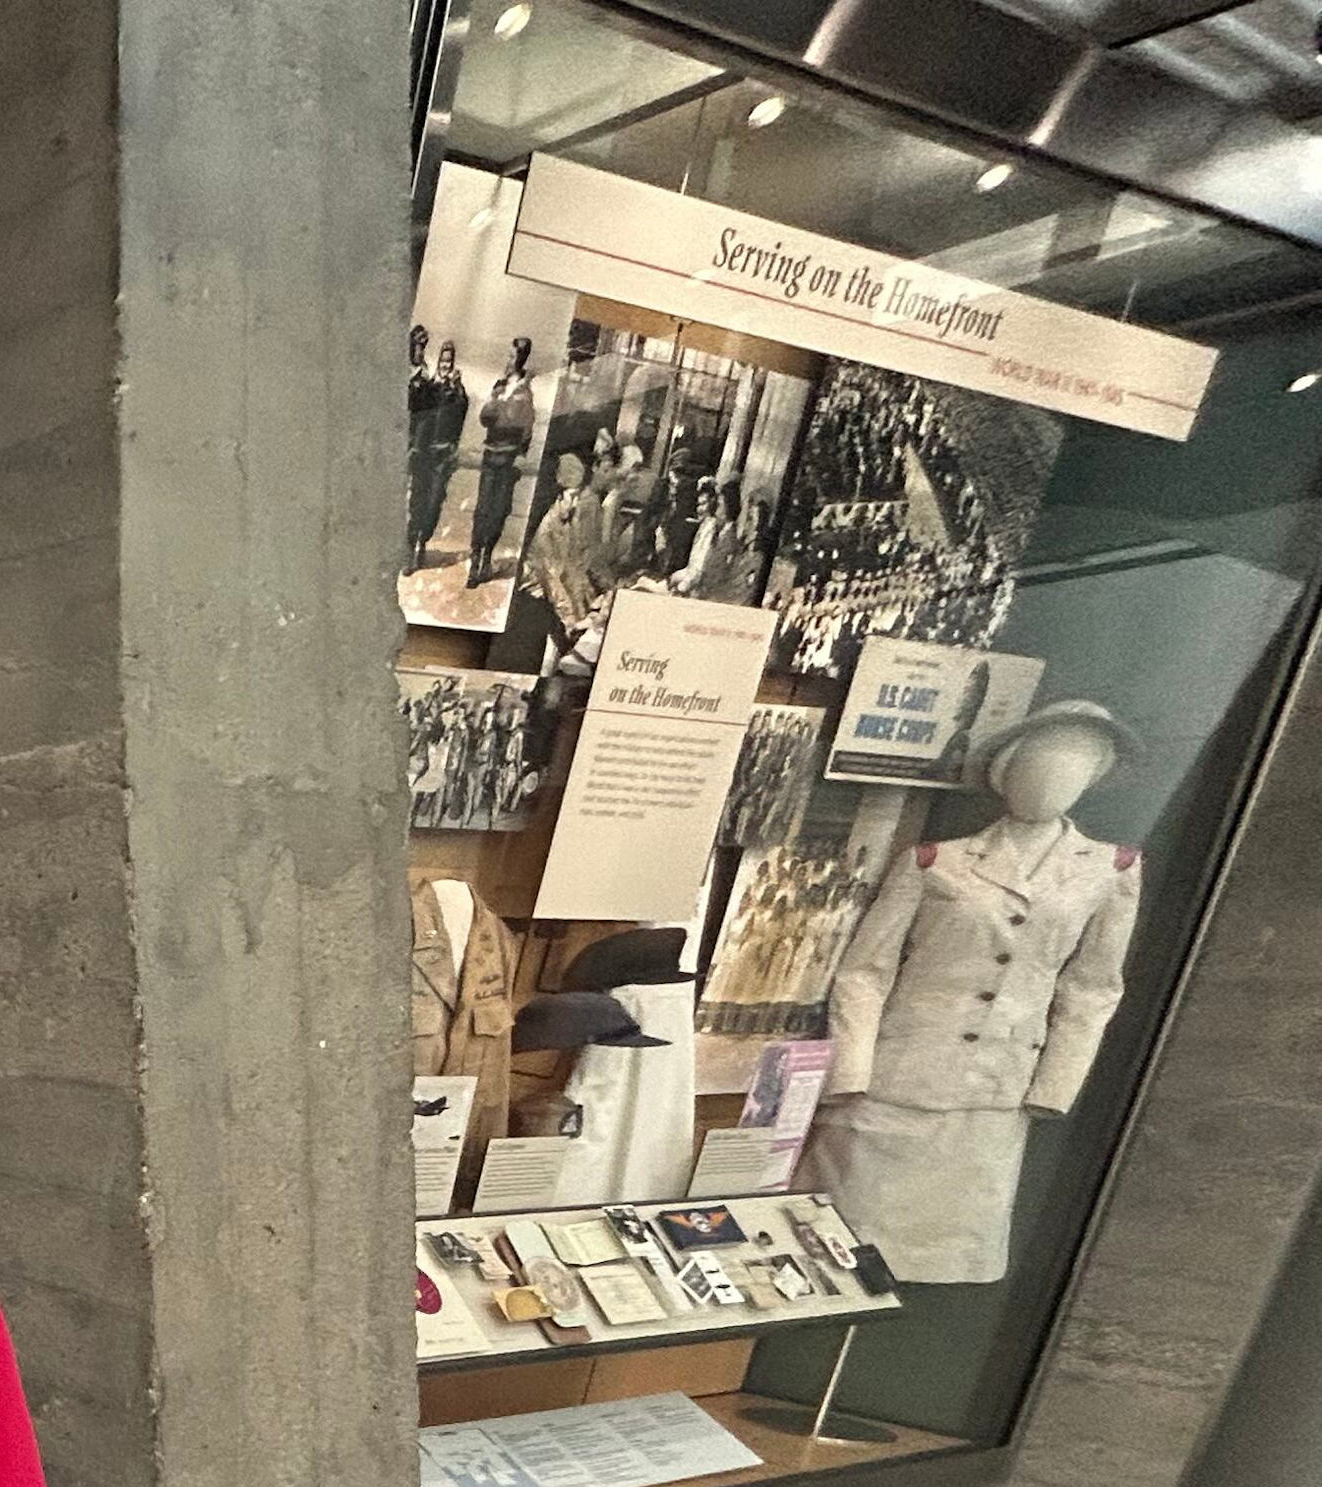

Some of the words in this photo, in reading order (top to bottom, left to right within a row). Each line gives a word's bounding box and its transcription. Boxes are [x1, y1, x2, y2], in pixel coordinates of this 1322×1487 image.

[712, 227, 810, 298] Serving
[809, 266, 842, 298] on
[843, 266, 884, 309] the
[883, 276, 1004, 342] Homefront
[617, 650, 671, 681] Serving
[608, 687, 628, 703] on
[628, 684, 652, 705] the
[651, 686, 722, 715] Homefront
